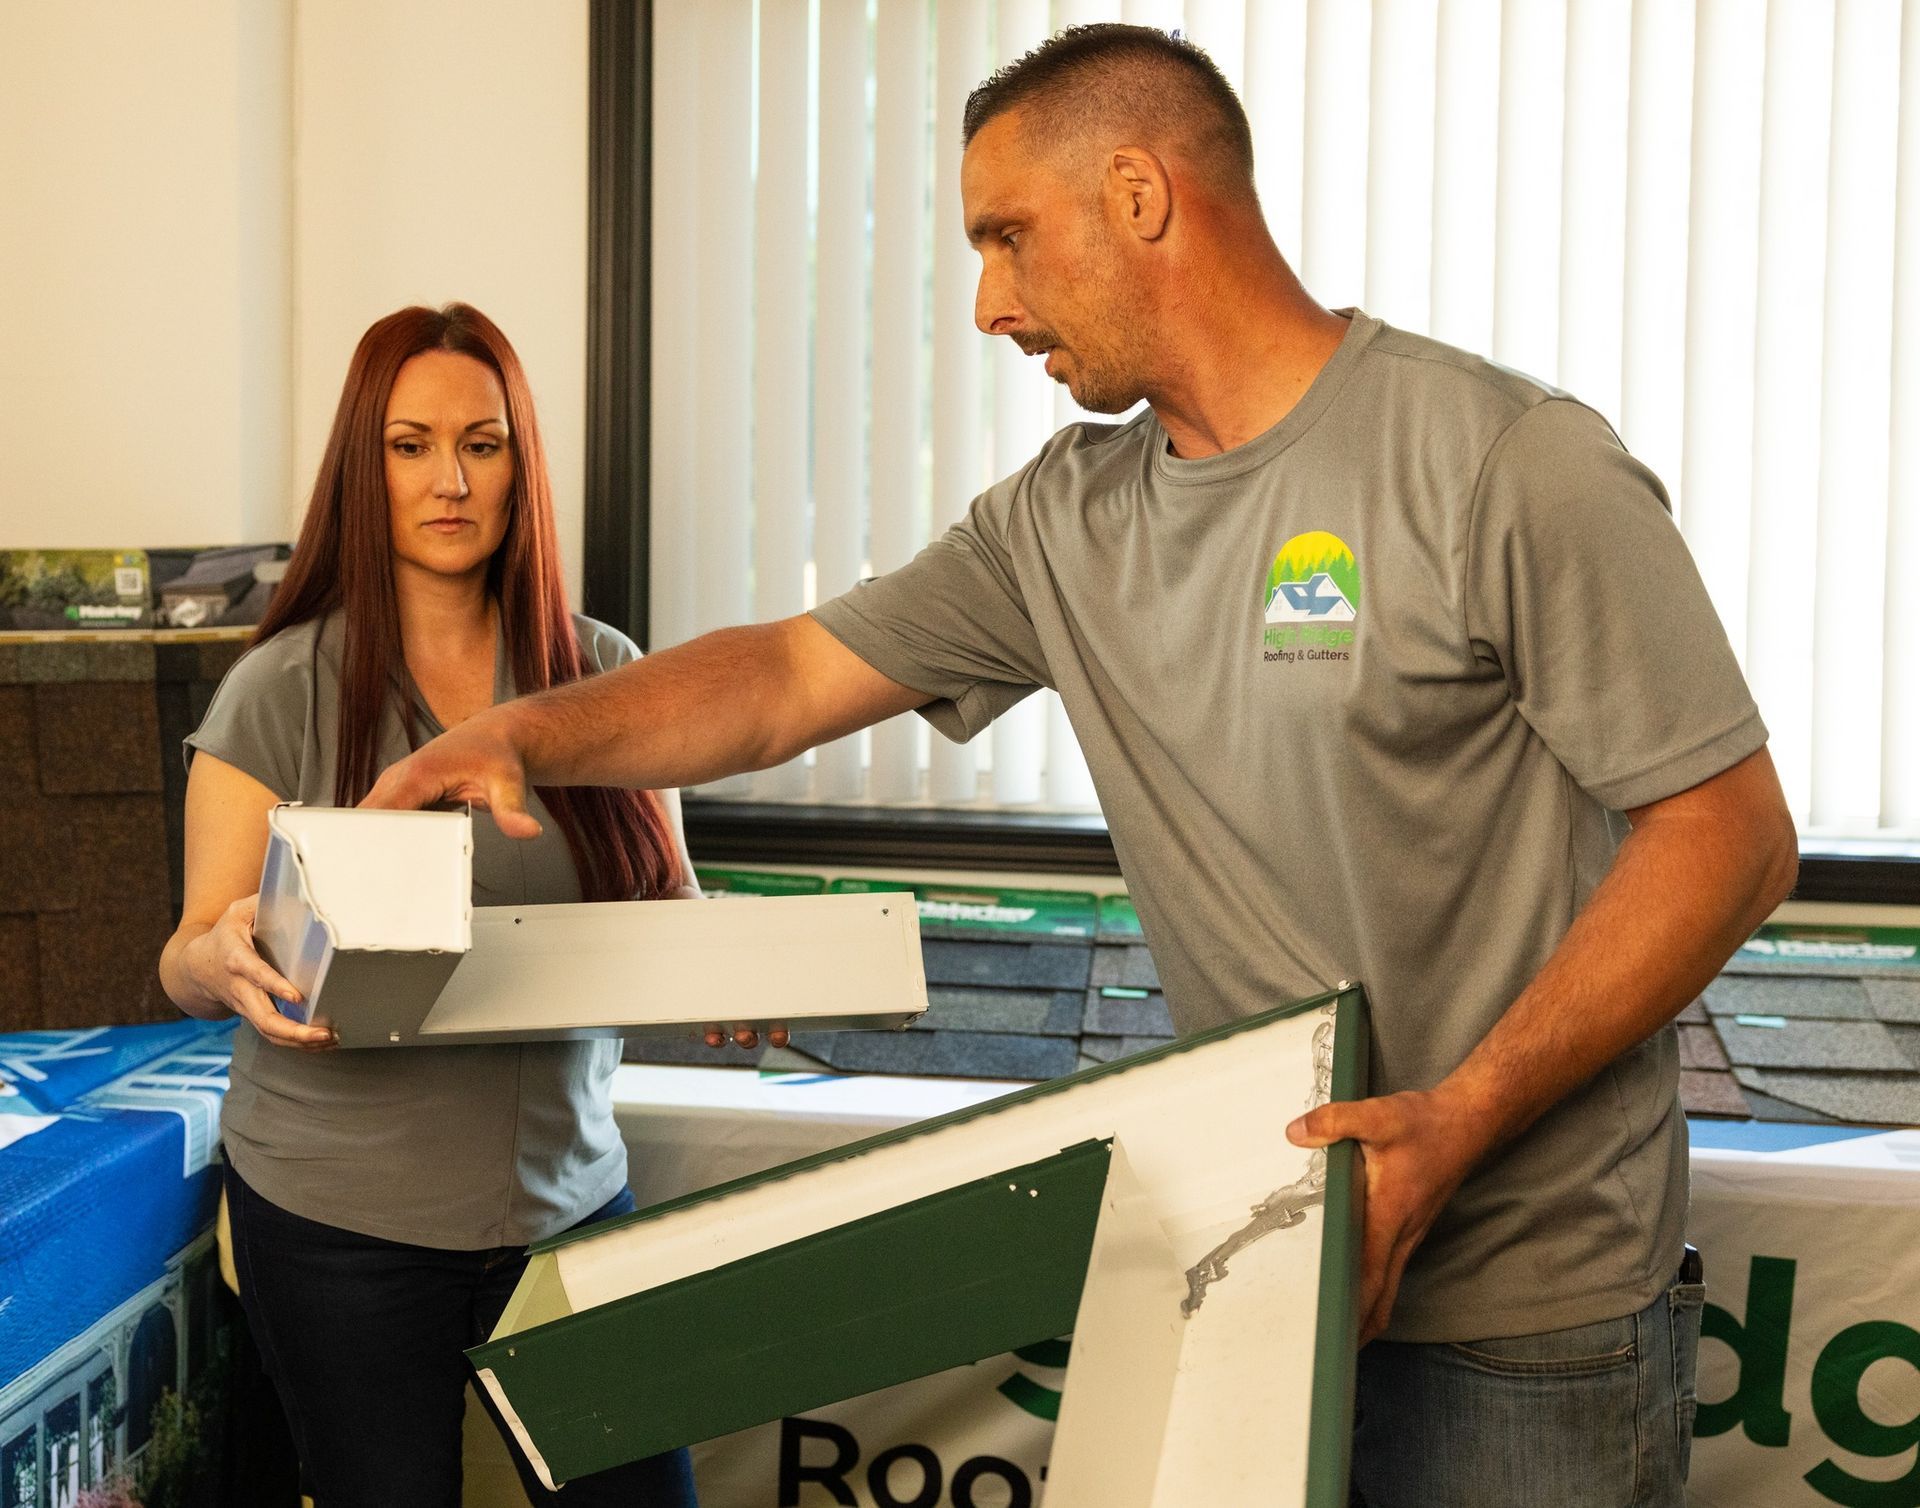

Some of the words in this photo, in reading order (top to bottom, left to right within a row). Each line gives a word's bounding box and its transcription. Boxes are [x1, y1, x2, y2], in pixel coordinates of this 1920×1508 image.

[1264, 627, 1296, 649] High
[1264, 650, 1295, 663] Roofing
[1297, 650, 1304, 660] &
[1307, 649, 1350, 661] Gutters
[778, 1417, 1048, 1508] Roo
